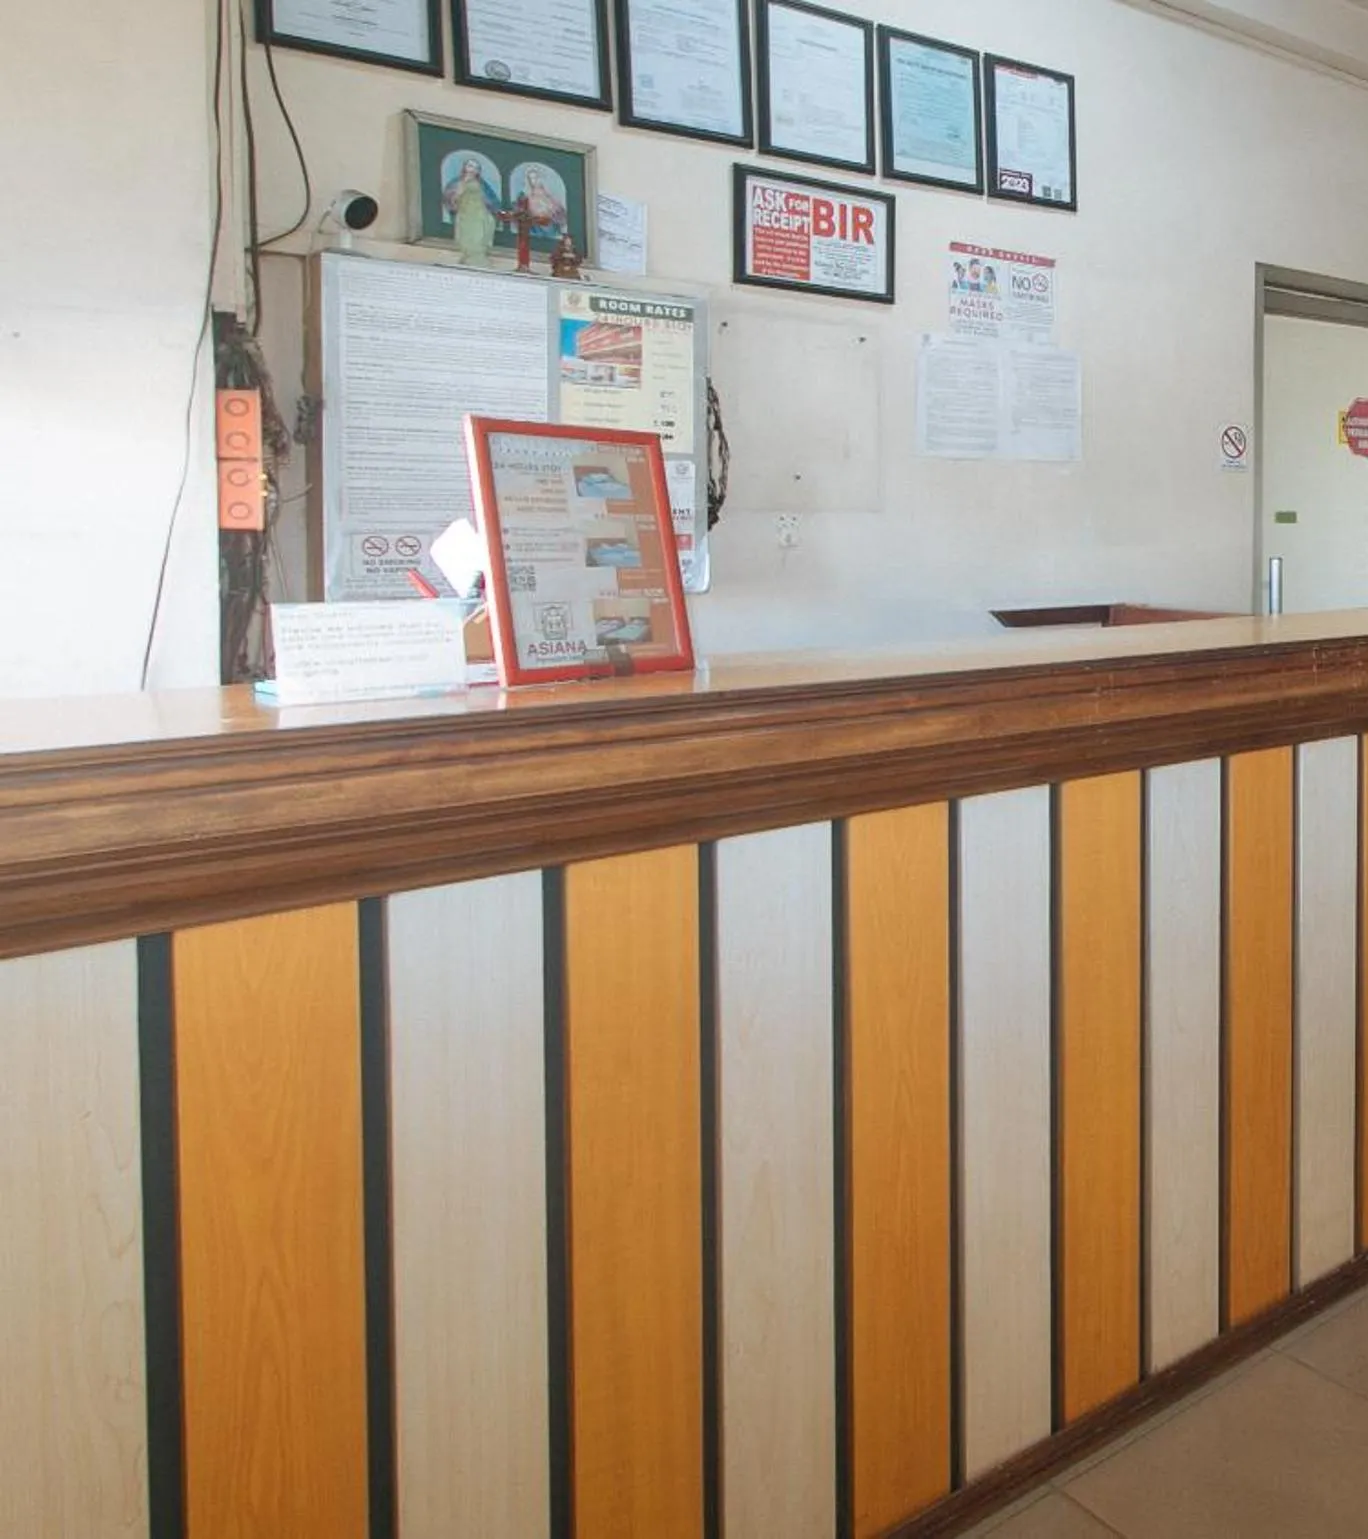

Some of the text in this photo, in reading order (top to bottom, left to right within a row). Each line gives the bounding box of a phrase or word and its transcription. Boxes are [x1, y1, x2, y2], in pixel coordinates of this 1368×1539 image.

[753, 187, 809, 212] ASK FOR
[753, 208, 810, 234] RECEIPT
[812, 198, 875, 246] BIR
[1011, 275, 1032, 292] NO
[599, 299, 687, 318] ROOM RATES
[527, 640, 588, 656] ASIANA
